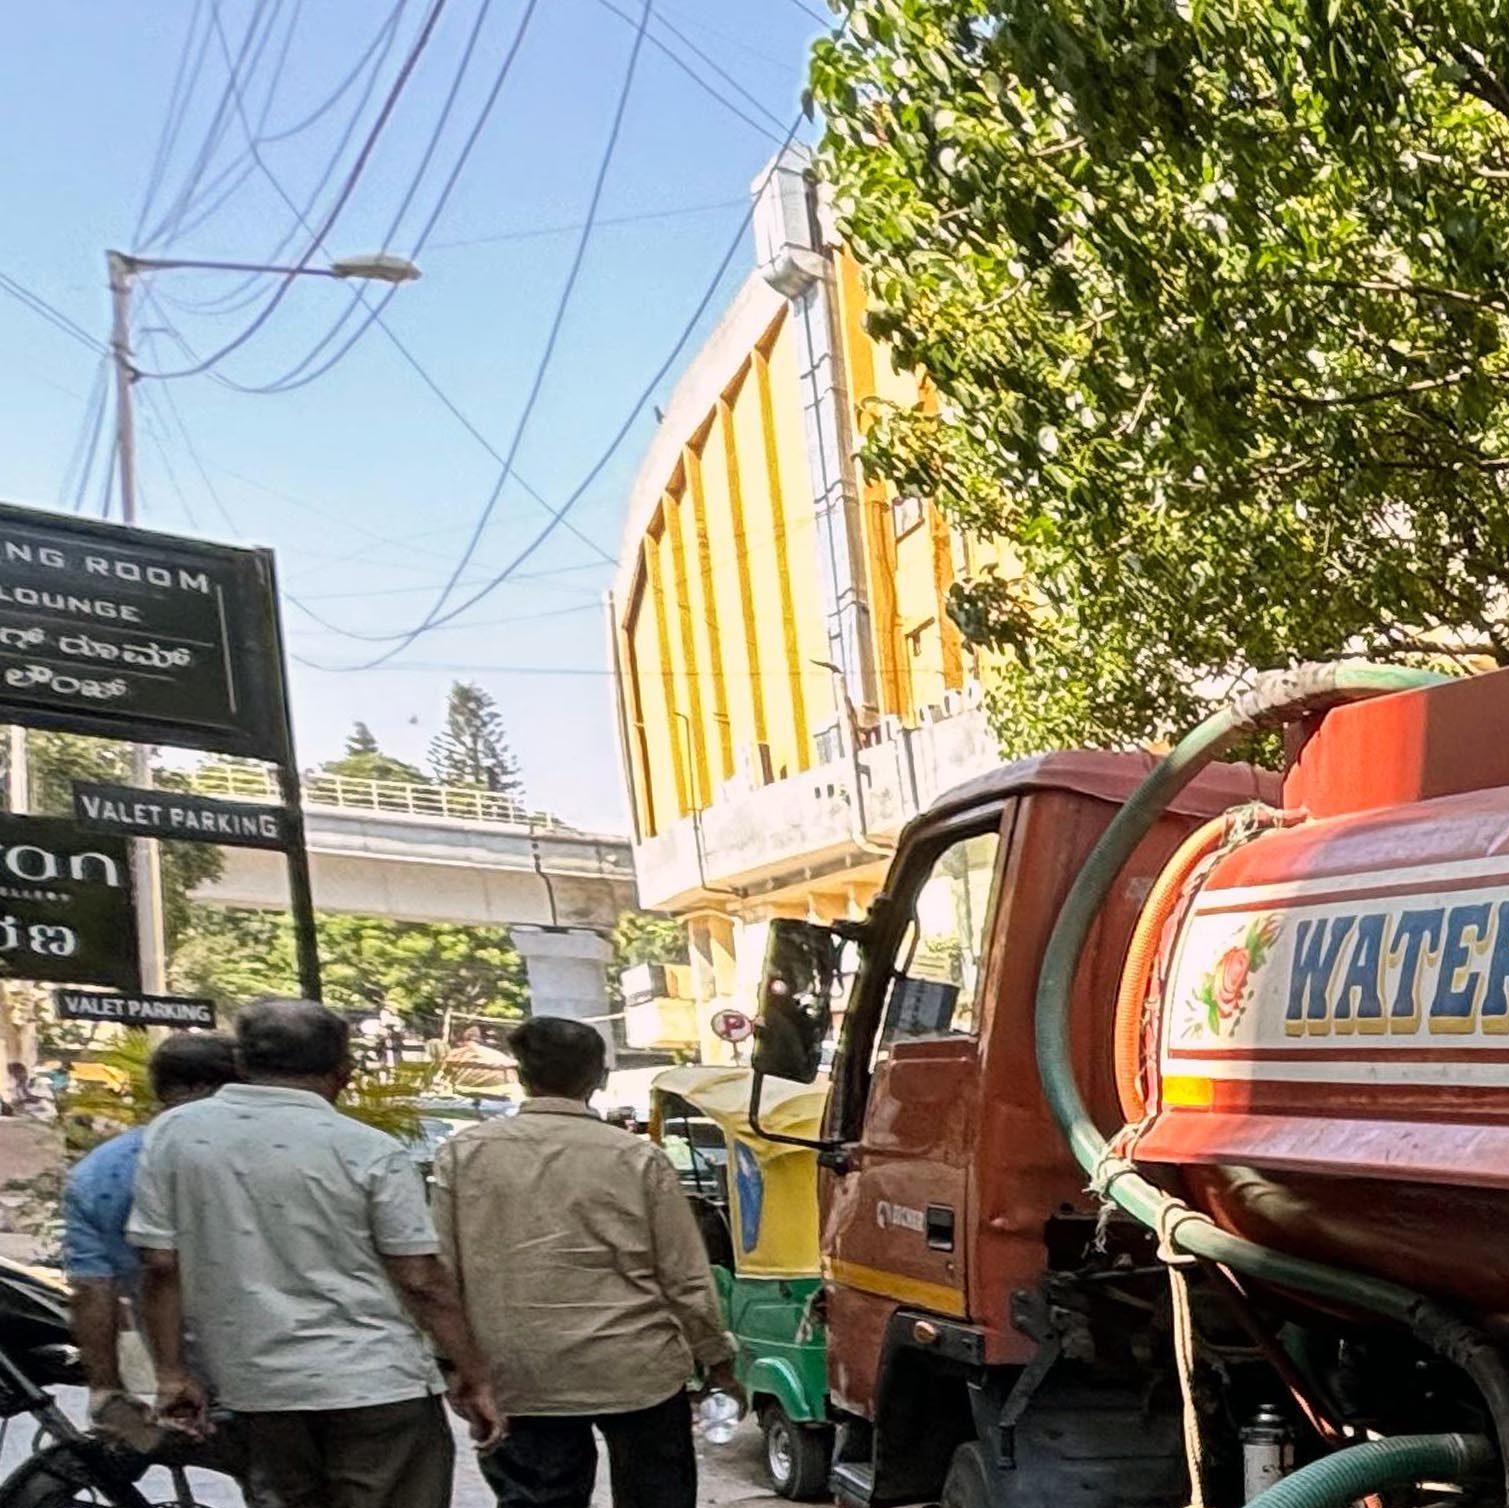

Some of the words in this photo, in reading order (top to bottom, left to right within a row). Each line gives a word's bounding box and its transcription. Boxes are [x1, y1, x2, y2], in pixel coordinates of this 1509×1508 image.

[84, 556, 210, 594] ROOM
[80, 796, 163, 827] VALET
[168, 806, 279, 839] PARKING
[0, 844, 120, 888] an
[64, 995, 126, 1016] VALET
[128, 999, 211, 1023] PARKING
